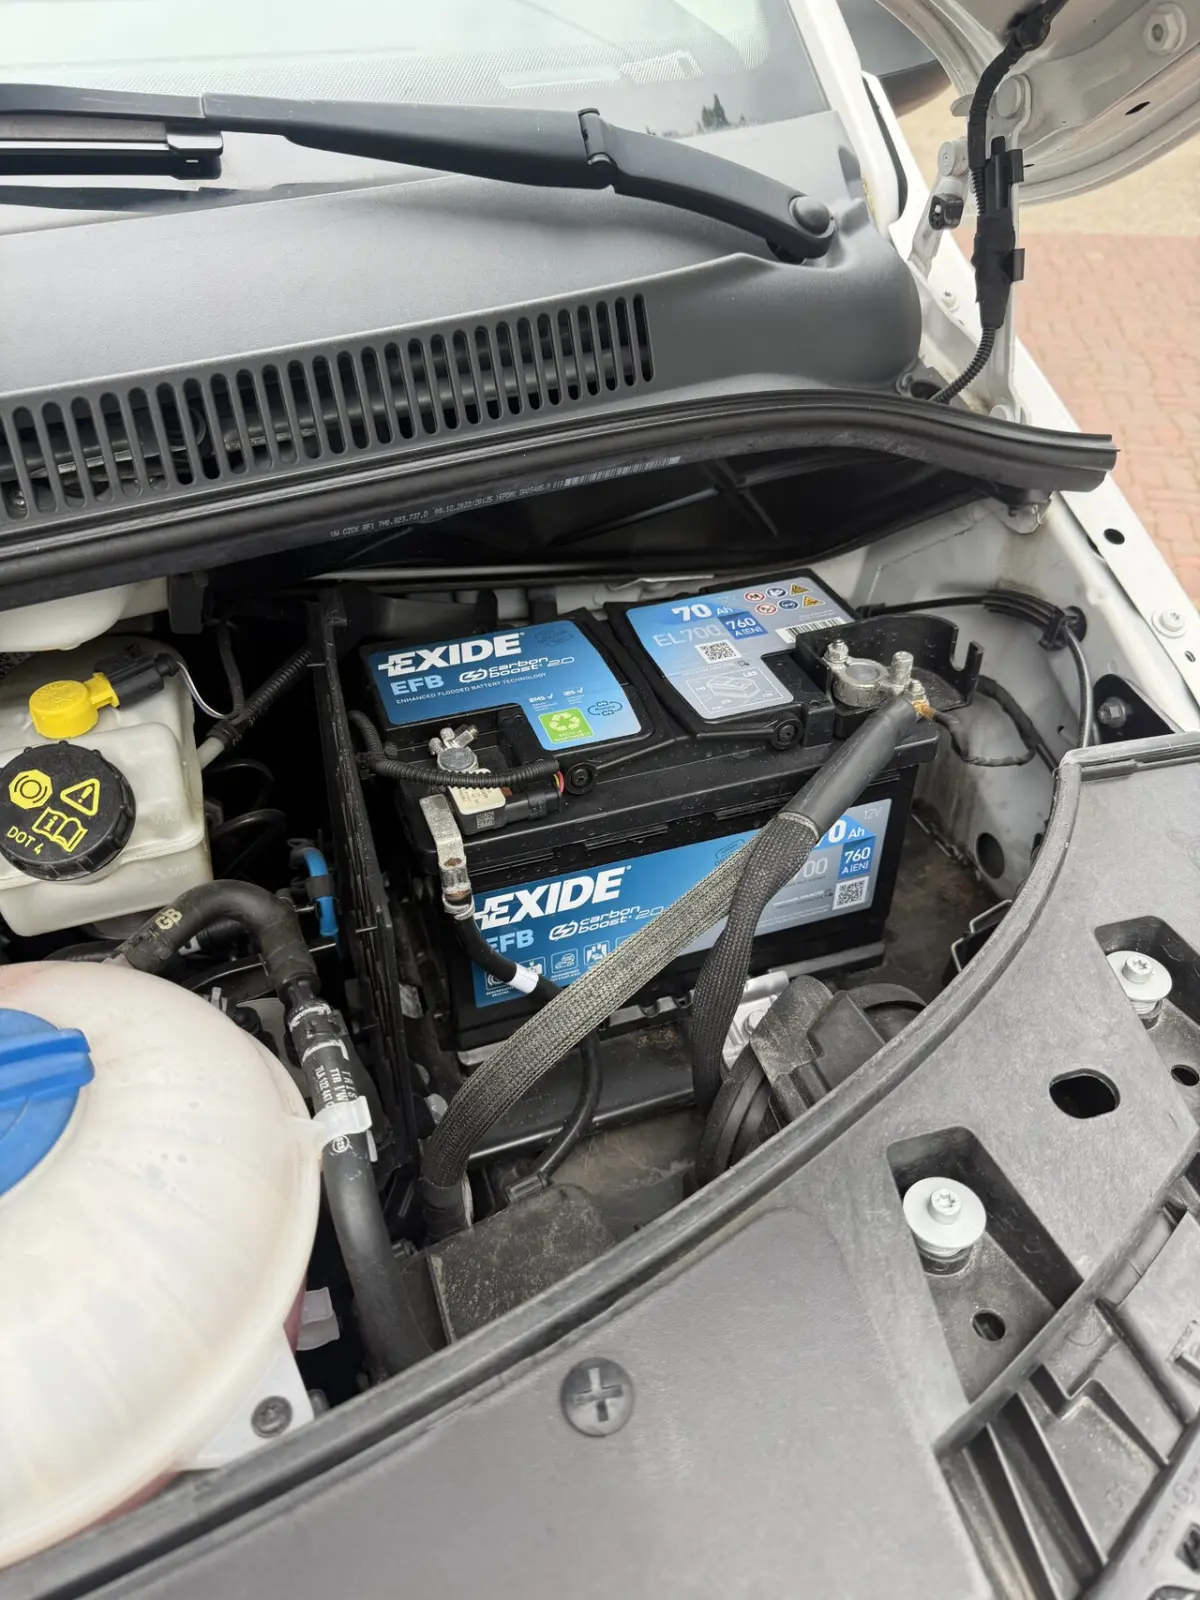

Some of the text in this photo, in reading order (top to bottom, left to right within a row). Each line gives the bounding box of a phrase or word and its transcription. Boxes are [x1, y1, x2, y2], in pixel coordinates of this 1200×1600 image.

[671, 603, 734, 622] 70 Ah
[725, 617, 757, 630] 760
[652, 624, 722, 647] EL700
[378, 632, 522, 678] EXIDE
[489, 657, 549, 672] carbon
[489, 663, 539, 678] boost
[390, 674, 445, 696] EFB
[396, 672, 547, 705] ENHANCED FLOODED BATTERY TECHNOLOGY
[7, 825, 44, 855] DOT 4
[848, 827, 865, 840] Ah
[844, 847, 871, 864] 760
[473, 866, 626, 931] EXIDE
[578, 915, 630, 934] boost
[580, 906, 641, 926] carbon
